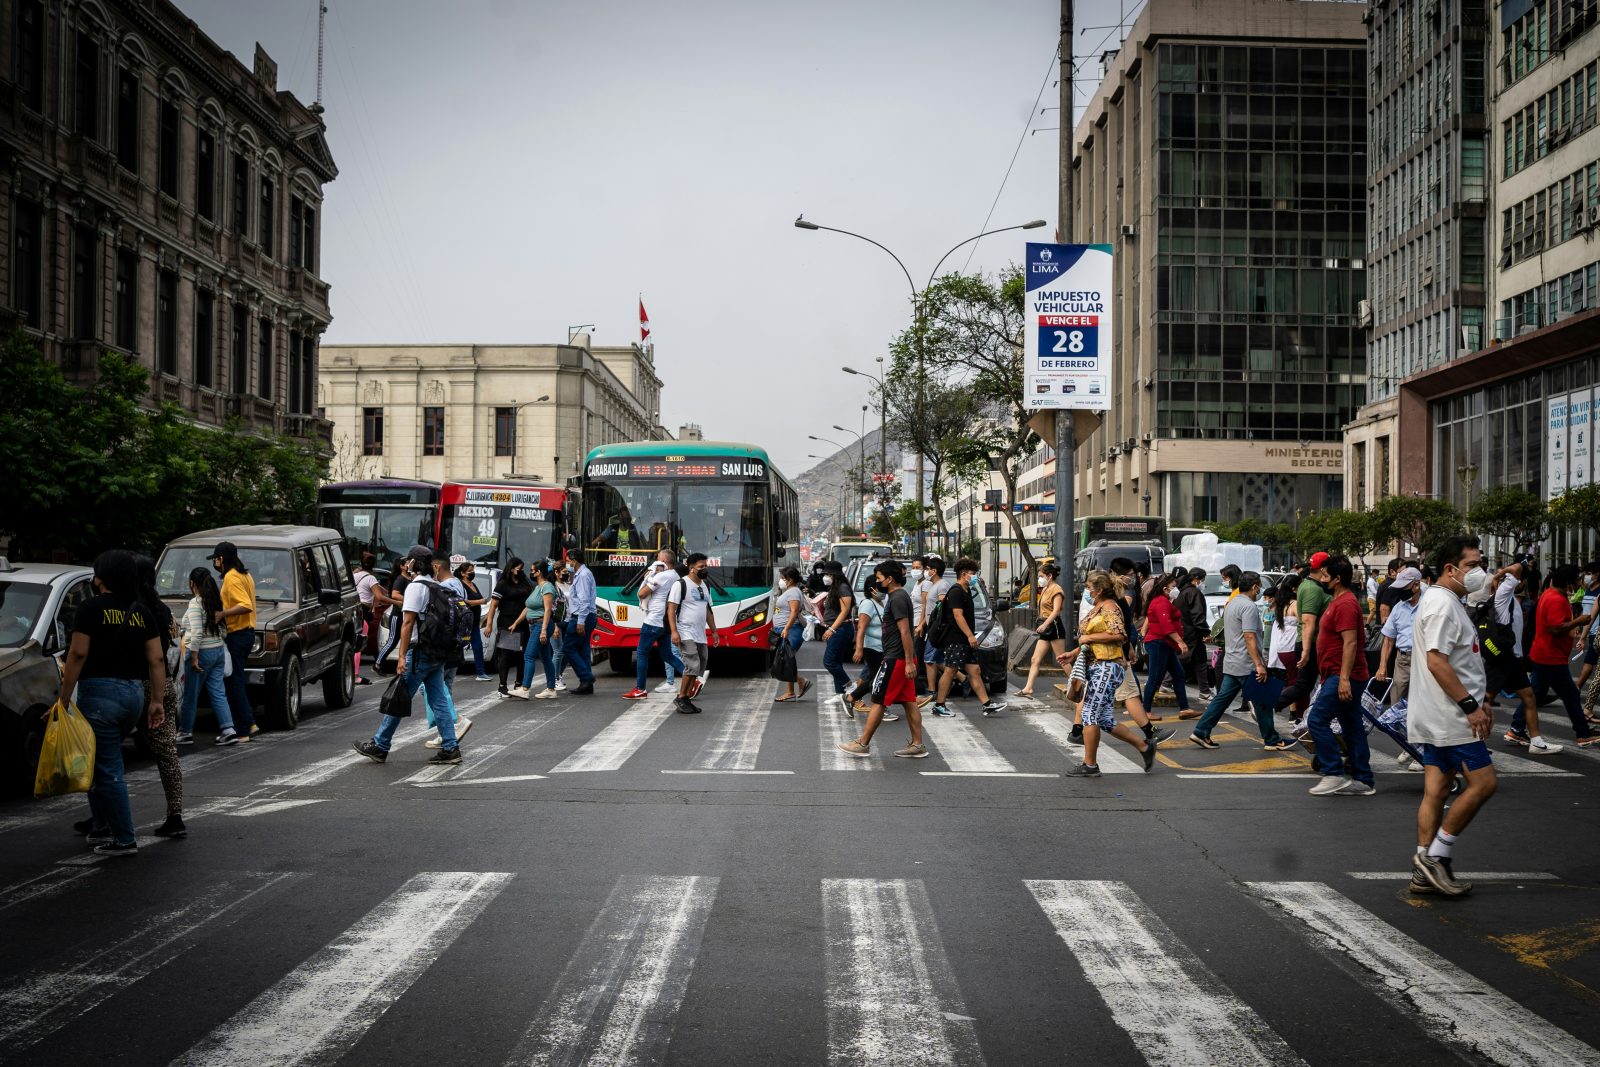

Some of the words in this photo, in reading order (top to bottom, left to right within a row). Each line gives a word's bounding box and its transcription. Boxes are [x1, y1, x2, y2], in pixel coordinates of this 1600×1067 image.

[1038, 291, 1100, 301] IMPUESTO
[1034, 302, 1104, 313] VEHICULAR
[1046, 316, 1077, 325] VENCE
[1081, 317, 1092, 325] EL
[1052, 330, 1084, 353] 28
[1551, 402, 1578, 418] ATENCÓN
[1551, 419, 1564, 430] PARA
[1265, 448, 1343, 458] MINISTERIO
[588, 464, 627, 477] CARABAYLLO
[722, 463, 740, 476] SAN
[743, 464, 763, 476] LUIS
[458, 506, 494, 517] MEXICO
[510, 508, 547, 521] ABANCAY
[478, 519, 495, 536] 49
[102, 609, 146, 628] NIRVNA
[1097, 661, 1111, 693] UNDER
